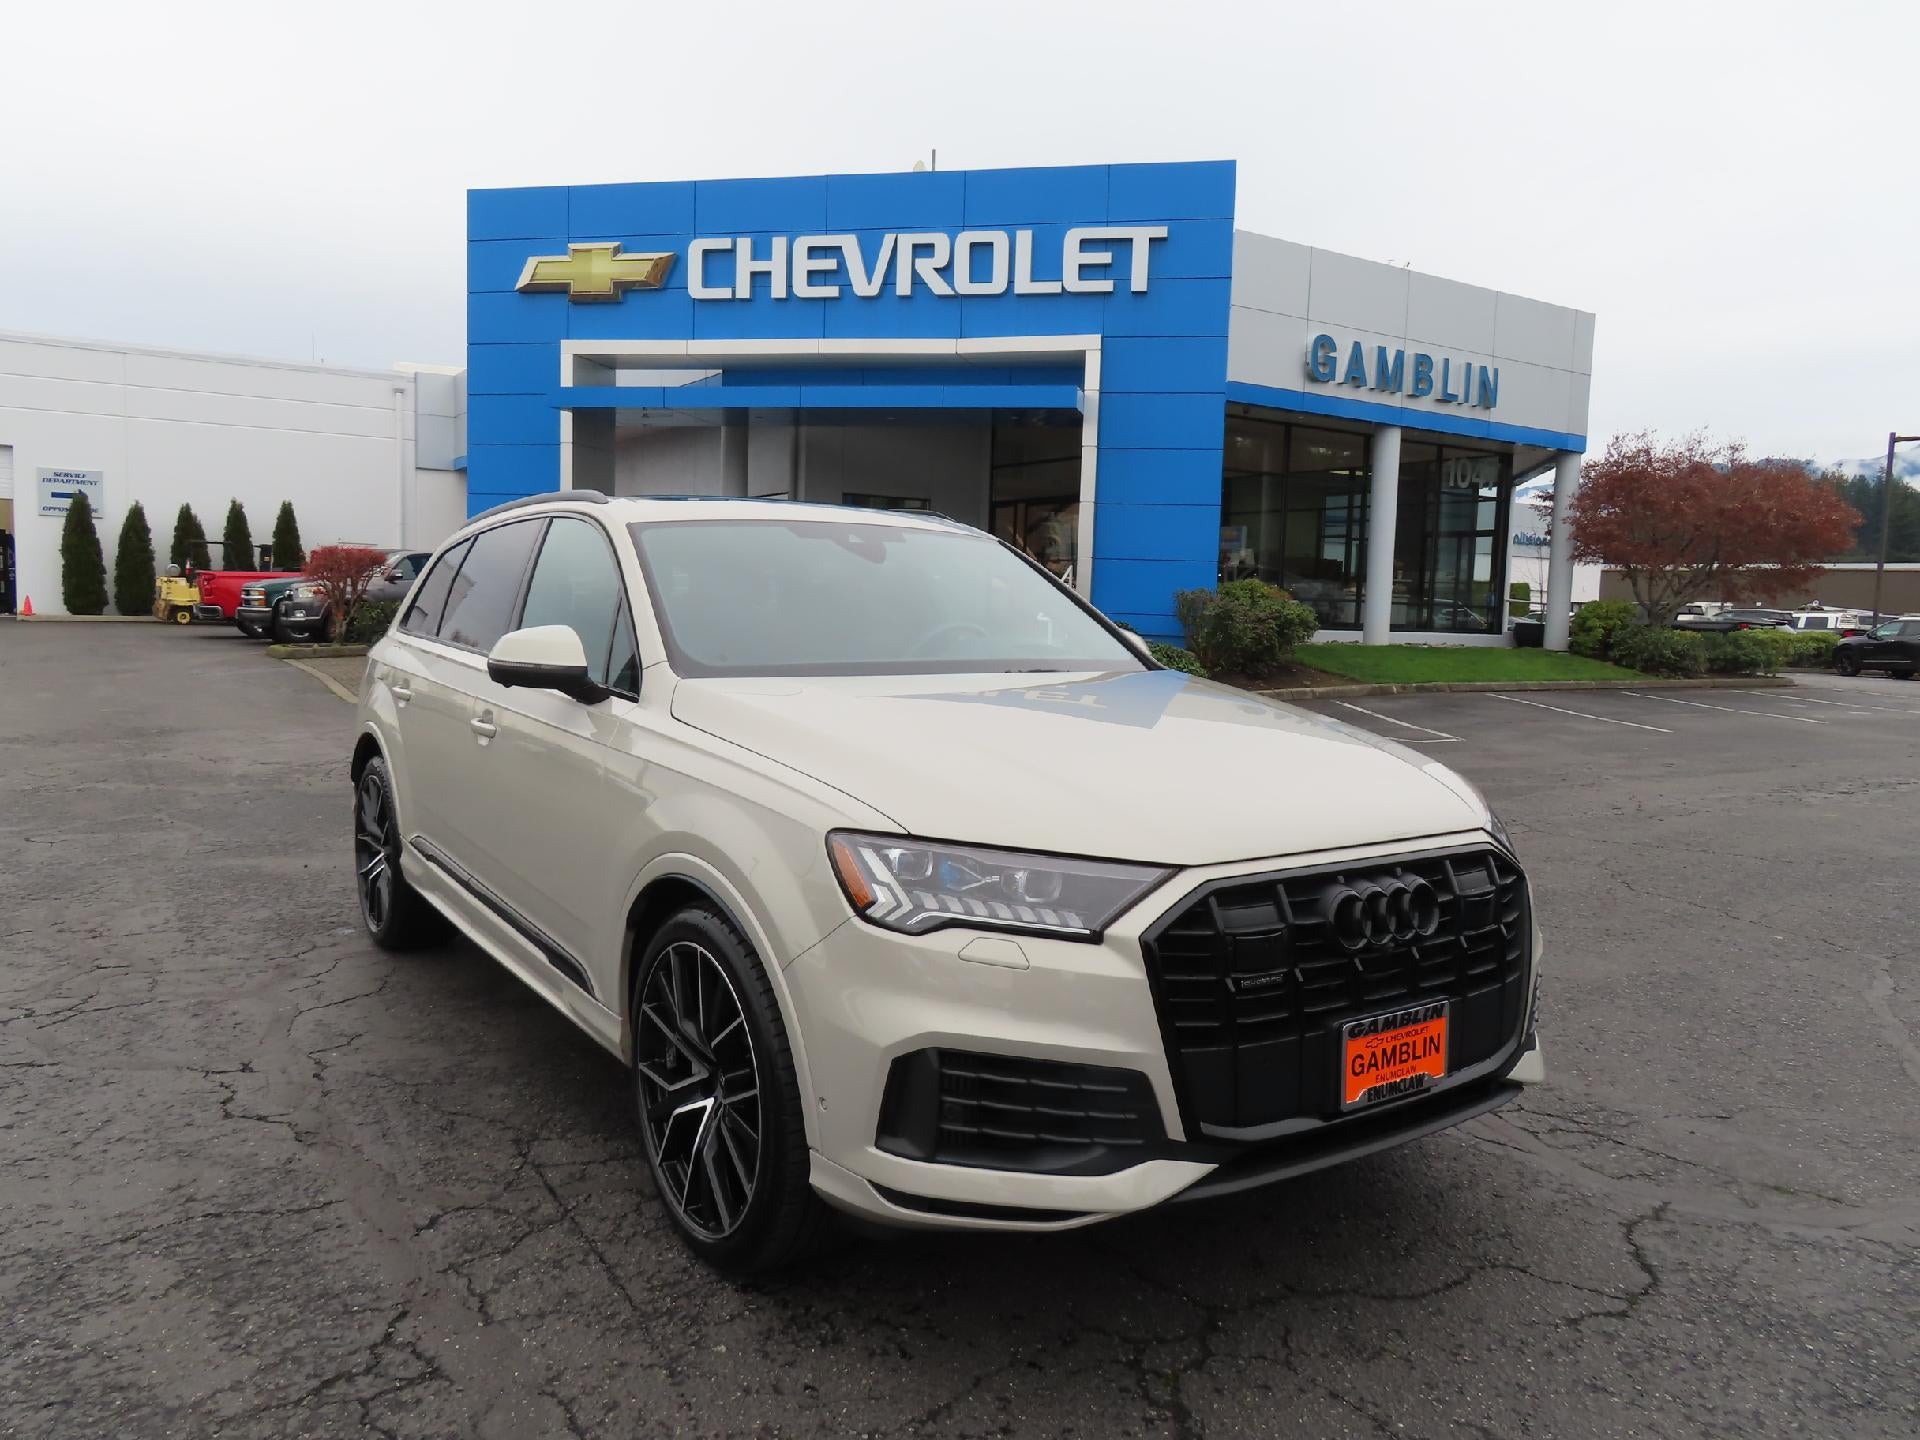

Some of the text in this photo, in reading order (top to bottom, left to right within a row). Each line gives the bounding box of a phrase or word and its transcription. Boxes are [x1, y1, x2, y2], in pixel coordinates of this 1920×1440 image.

[688, 226, 1169, 299] CHEVROLET
[1309, 334, 1499, 409] GAMBLIN
[42, 477, 99, 486] DEPARTMENT
[1348, 1002, 1446, 1039] GAMBLIN
[1385, 1025, 1430, 1044] CHEVROLET
[1351, 1033, 1441, 1078] GAMBLIN
[1366, 1073, 1427, 1103] ENUMCLAW
[1375, 1065, 1417, 1083] ENUMCLAW
